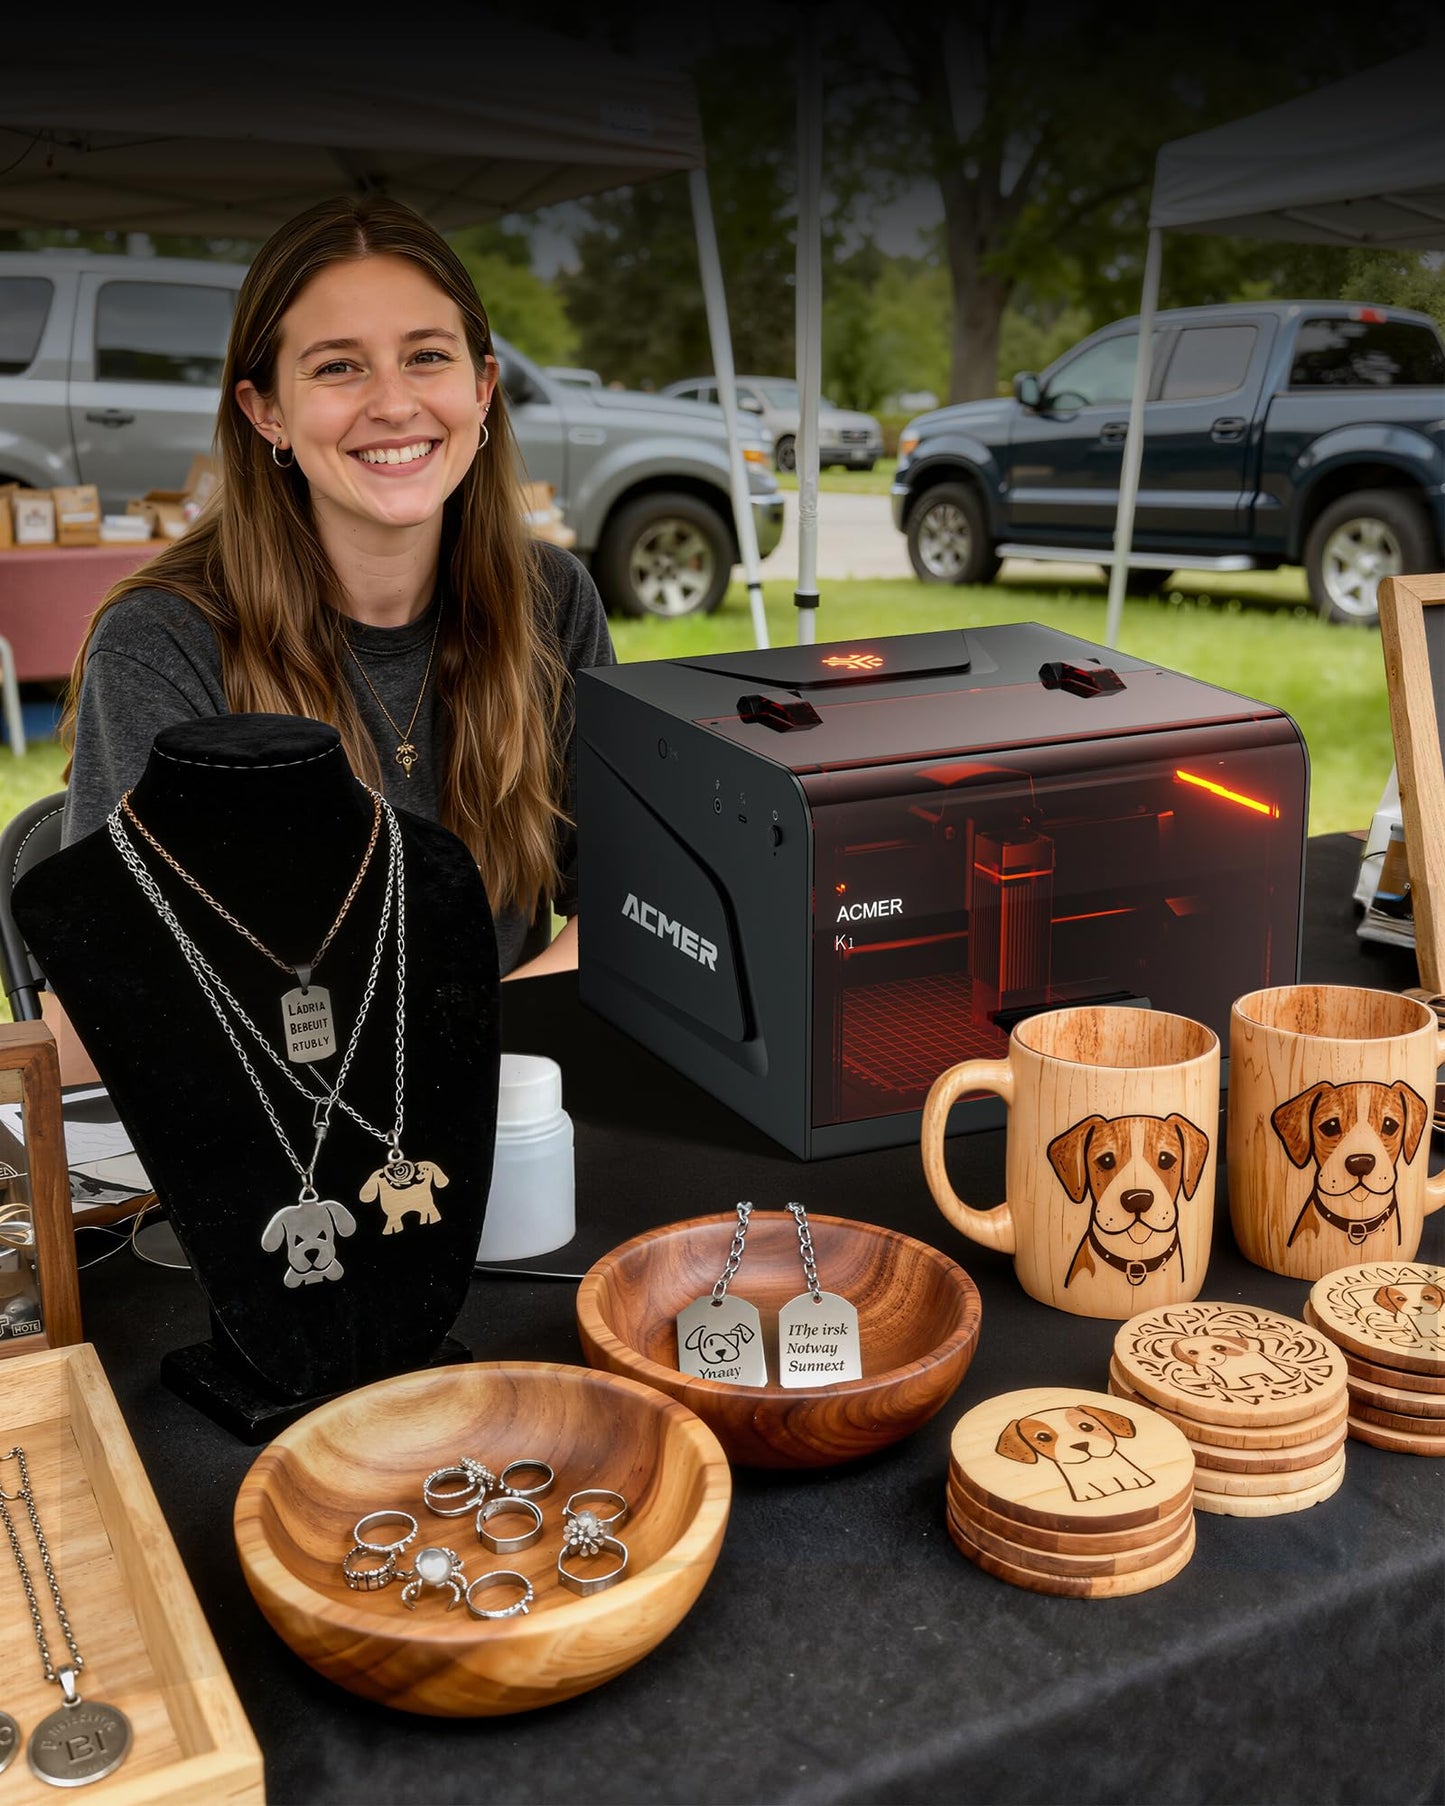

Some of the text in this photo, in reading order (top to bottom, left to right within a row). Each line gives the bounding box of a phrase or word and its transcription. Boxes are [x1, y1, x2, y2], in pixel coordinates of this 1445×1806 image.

[836, 898, 903, 922] ACMER
[620, 893, 718, 972] ACMER
[786, 1342, 838, 1357] Notway
[788, 1360, 845, 1372] Sunnext
